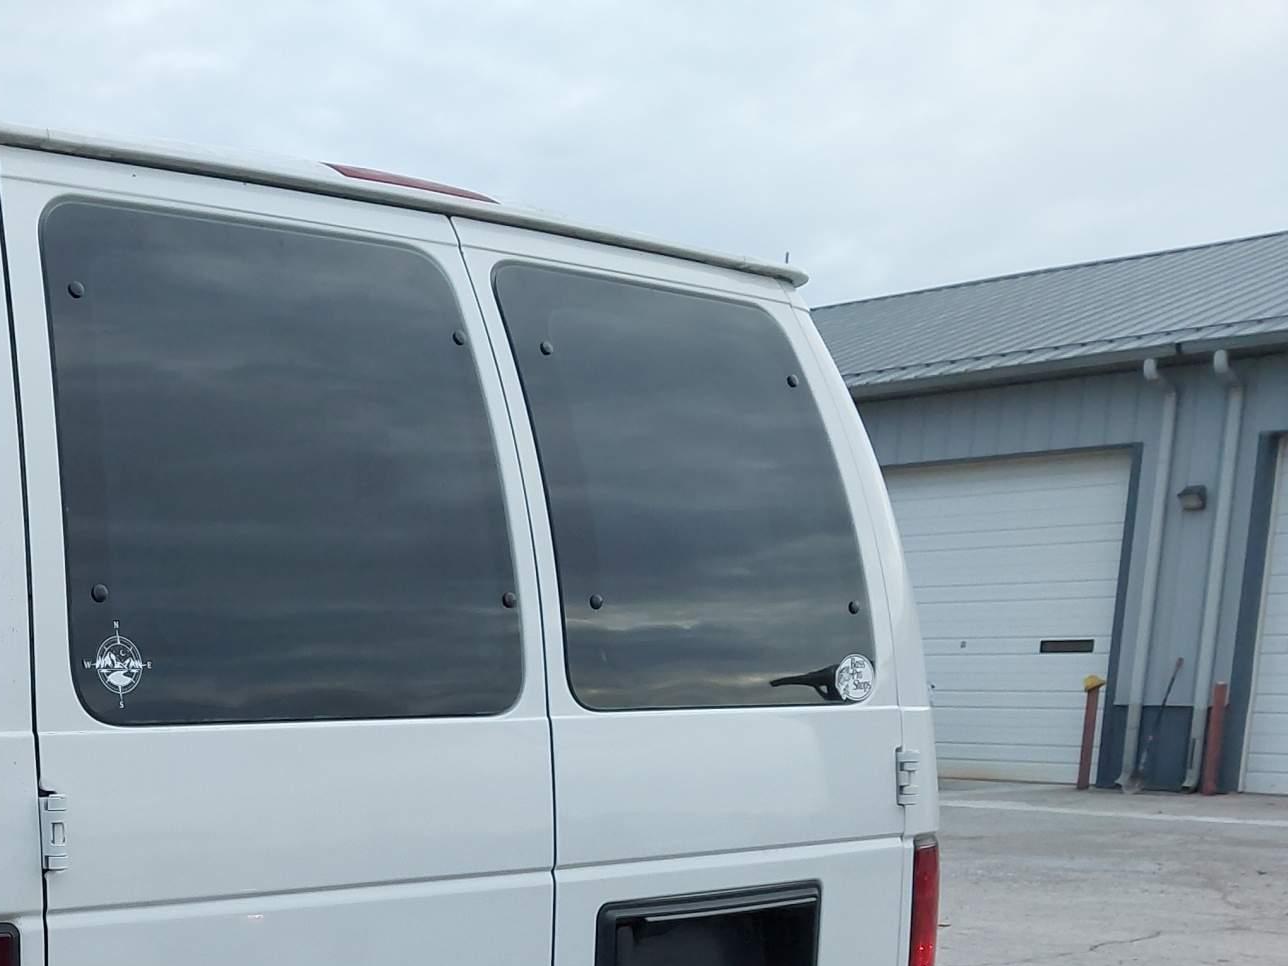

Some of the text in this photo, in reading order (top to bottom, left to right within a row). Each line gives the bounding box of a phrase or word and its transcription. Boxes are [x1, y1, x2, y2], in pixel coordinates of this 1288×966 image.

[114, 621, 119, 629] N
[83, 660, 92, 669] W
[119, 701, 124, 709] S
